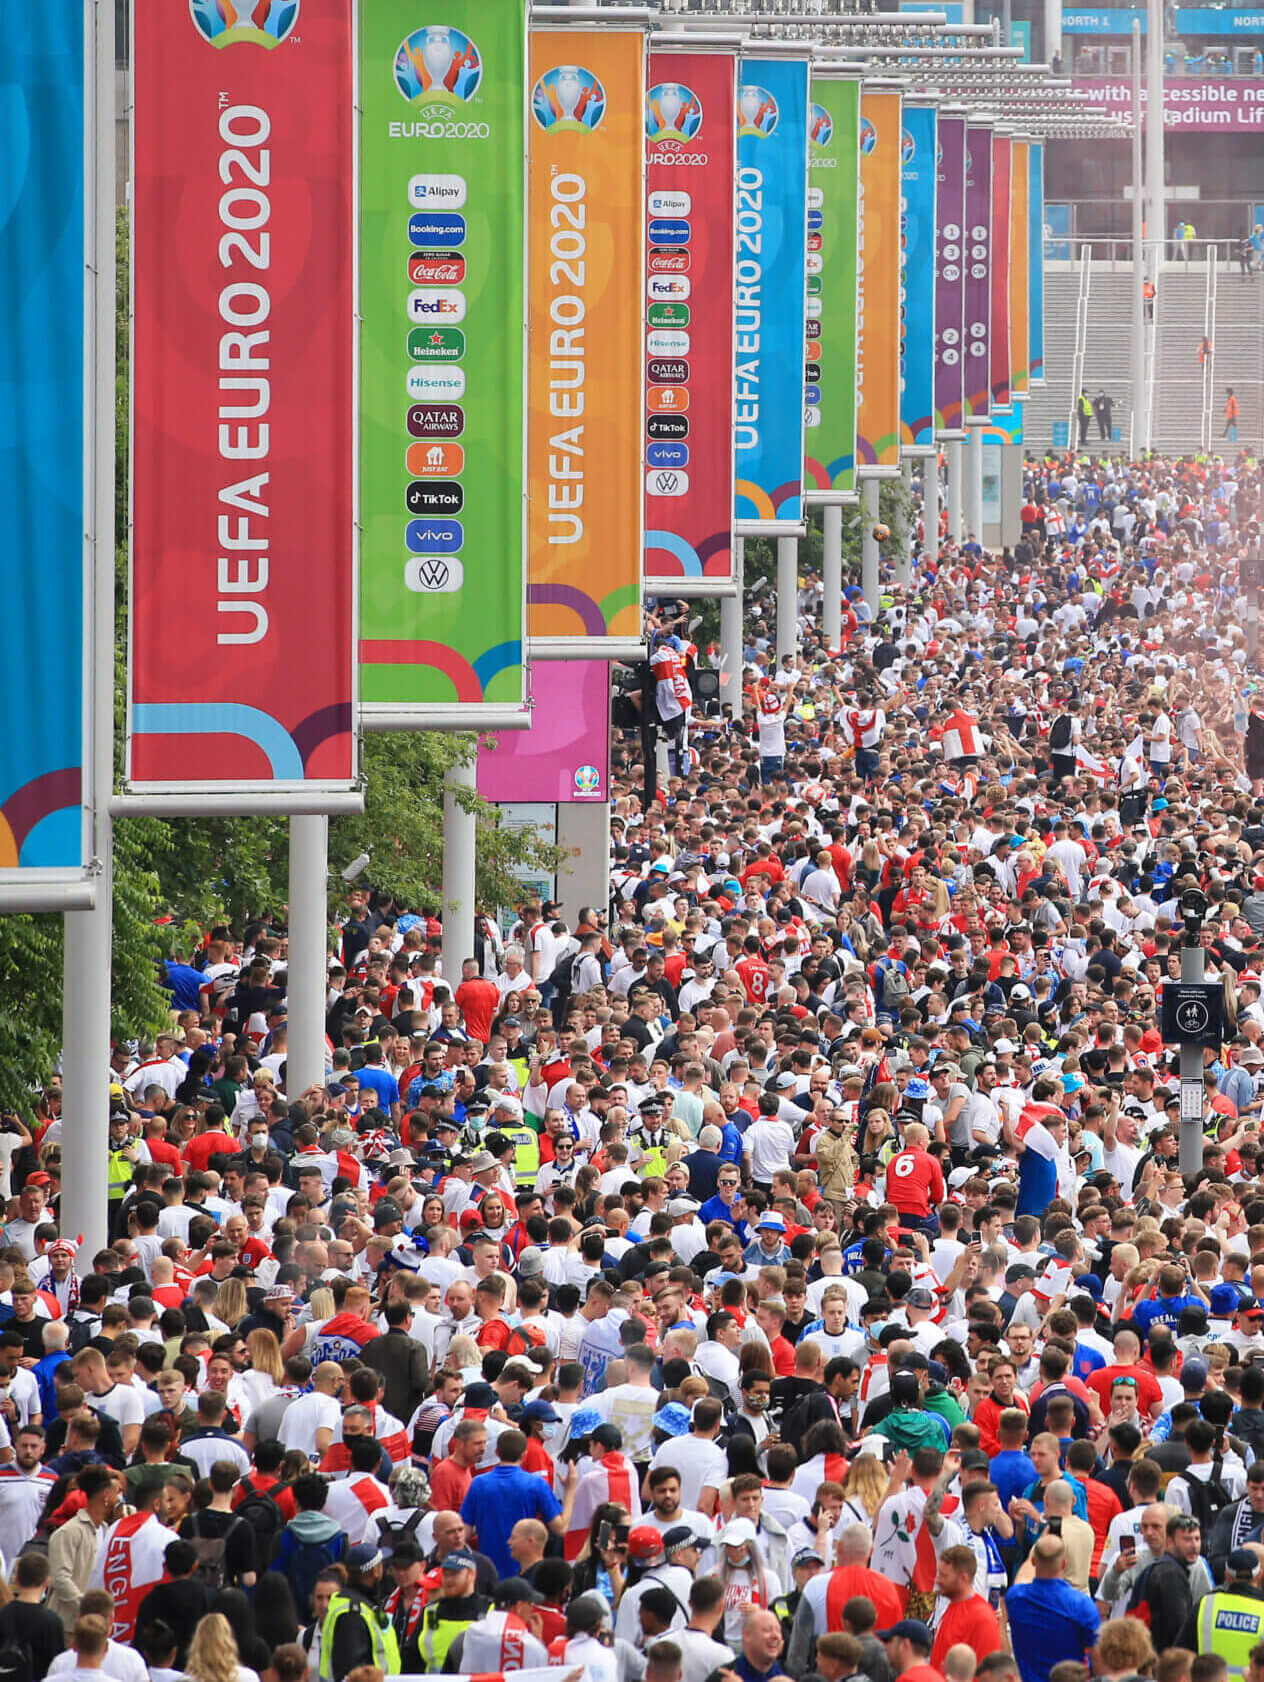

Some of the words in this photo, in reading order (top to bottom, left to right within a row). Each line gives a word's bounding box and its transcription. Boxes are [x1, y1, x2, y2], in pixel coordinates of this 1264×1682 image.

[1088, 85, 1131, 102] with
[388, 121, 490, 139] EURO2020
[428, 186, 460, 197] Alipay
[410, 224, 463, 234] Booking.com
[652, 282, 685, 293] FedEx
[414, 299, 458, 313] FedEx
[736, 259, 763, 354] EURO
[413, 346, 459, 356] Heineken
[548, 295, 586, 418] EURO
[217, 283, 271, 459] EURO
[651, 363, 685, 374] QATAR
[410, 378, 462, 388] Hisense
[734, 359, 760, 449] UEFA
[412, 411, 458, 424] QATAR
[423, 423, 459, 431] AIRWAYS
[659, 424, 686, 432] TikTok
[653, 450, 681, 458] vivo
[548, 425, 586, 544] UEFA
[423, 494, 459, 504] TikTok
[416, 529, 453, 541] vivo
[217, 471, 270, 645] UEFA
[752, 972, 764, 995] 8
[895, 1154, 915, 1177] 6
[1216, 1612, 1258, 1632] POLICE
